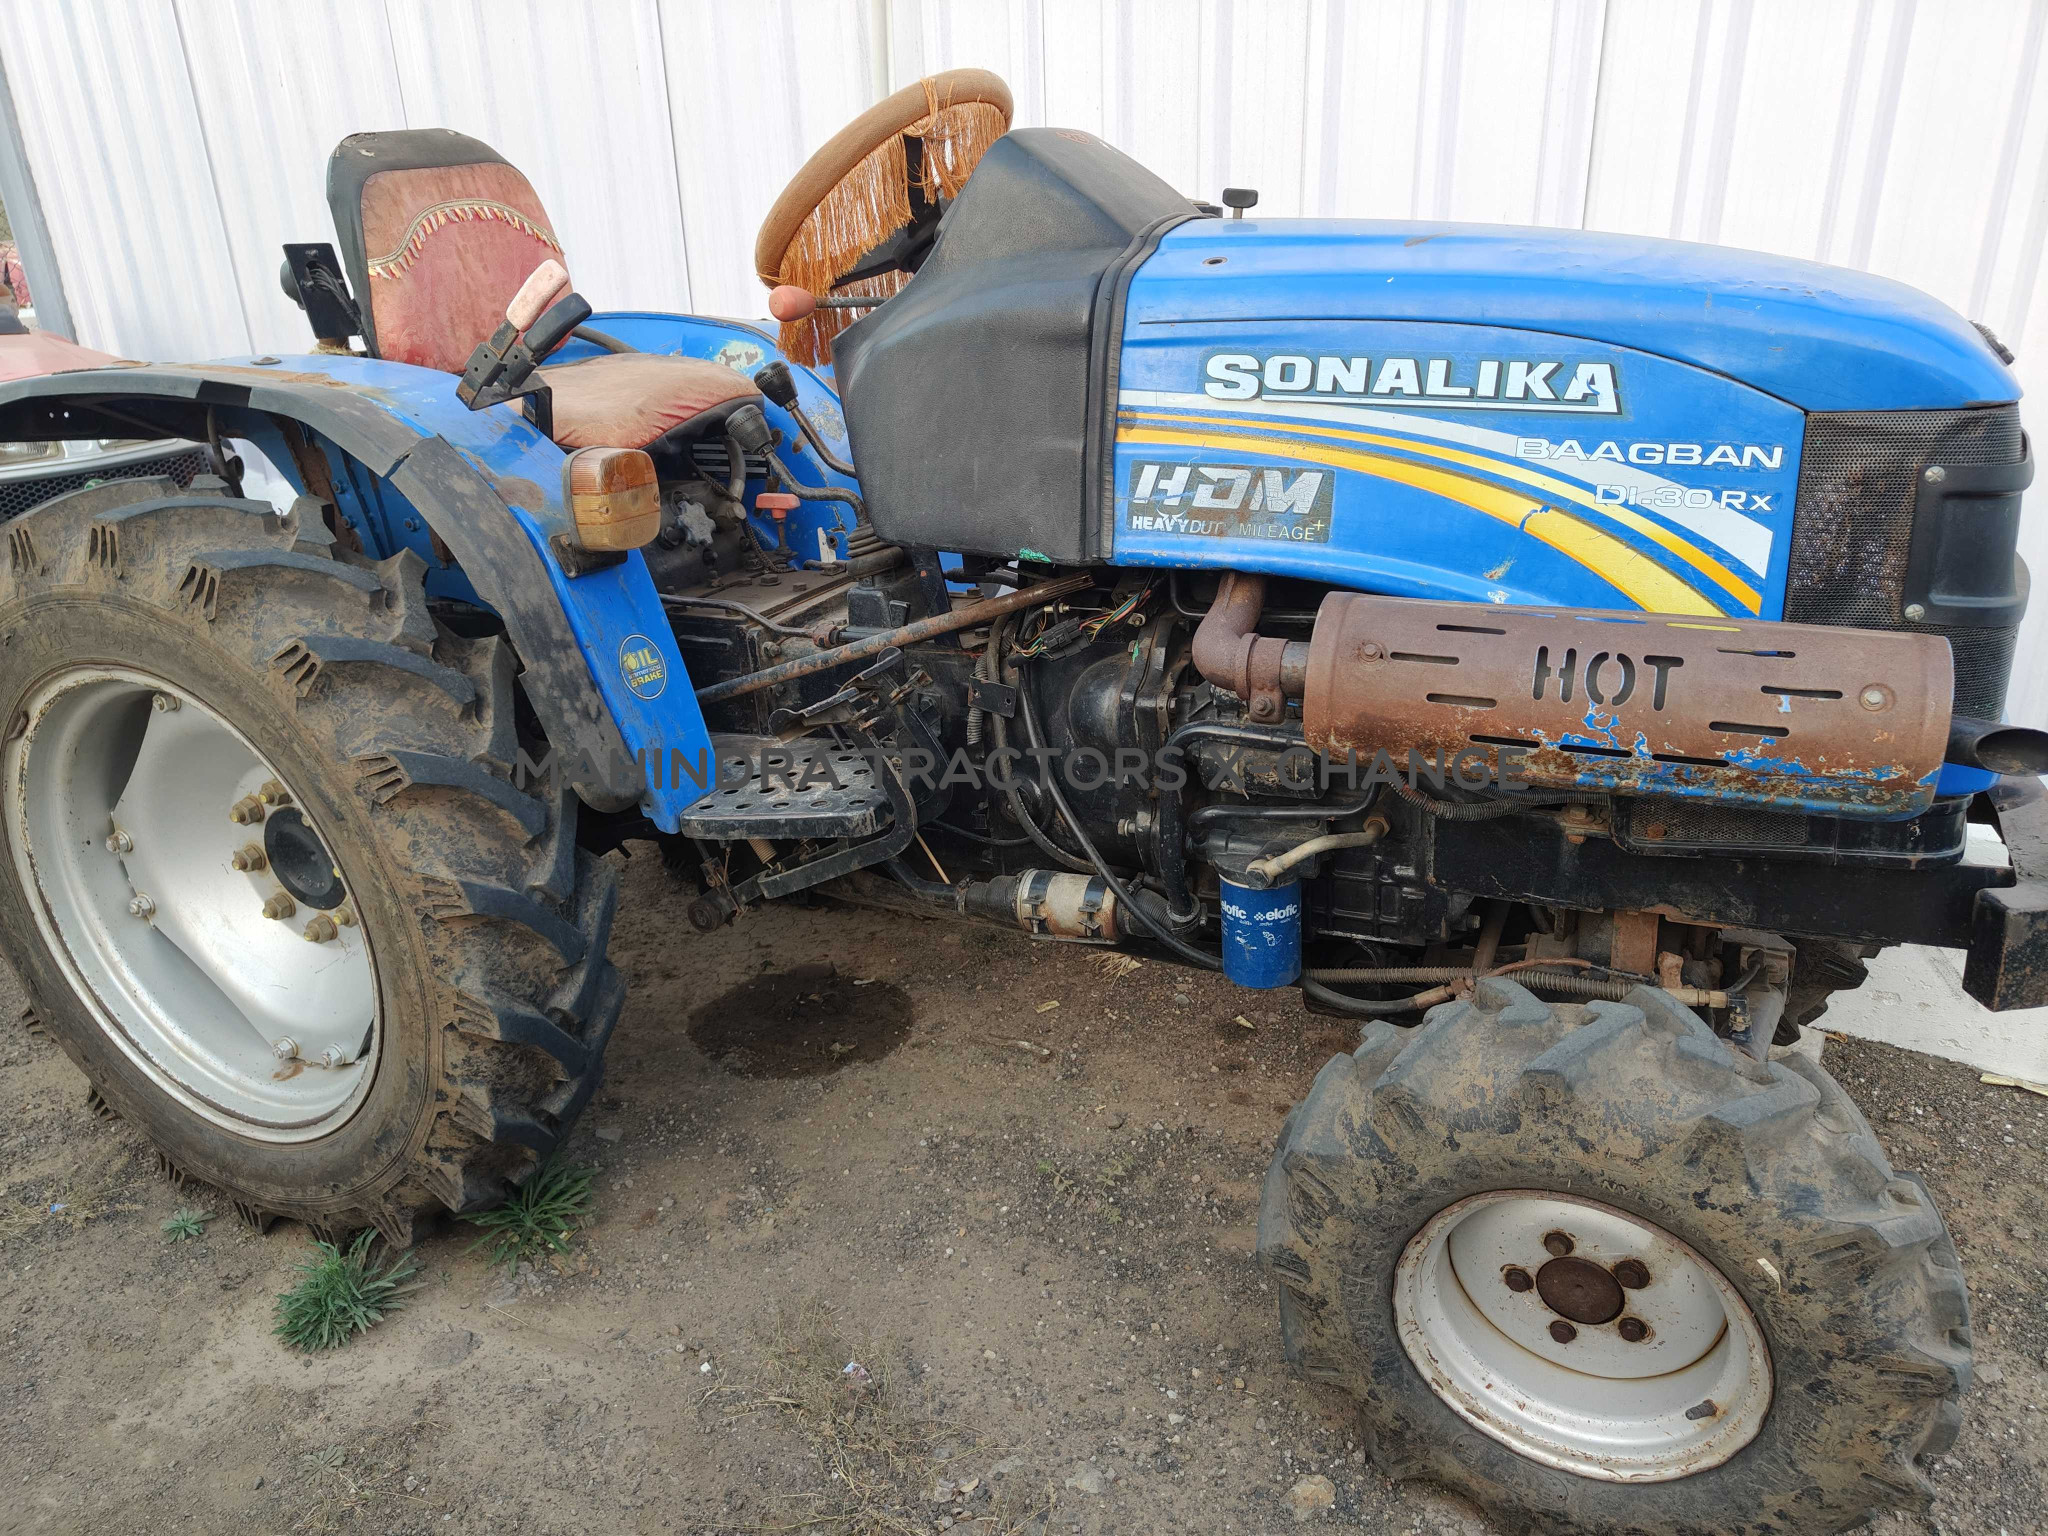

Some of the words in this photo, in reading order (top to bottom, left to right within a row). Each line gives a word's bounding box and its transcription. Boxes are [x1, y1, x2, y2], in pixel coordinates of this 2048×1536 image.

[1204, 354, 1622, 414] SONALIKA
[1515, 437, 1783, 469] BAAGBAN
[1133, 465, 1323, 514] HDM
[623, 648, 659, 671] OIL
[631, 670, 664, 688] BRAKE
[1533, 645, 1684, 711] HOT
[1265, 904, 1298, 920] elofic
